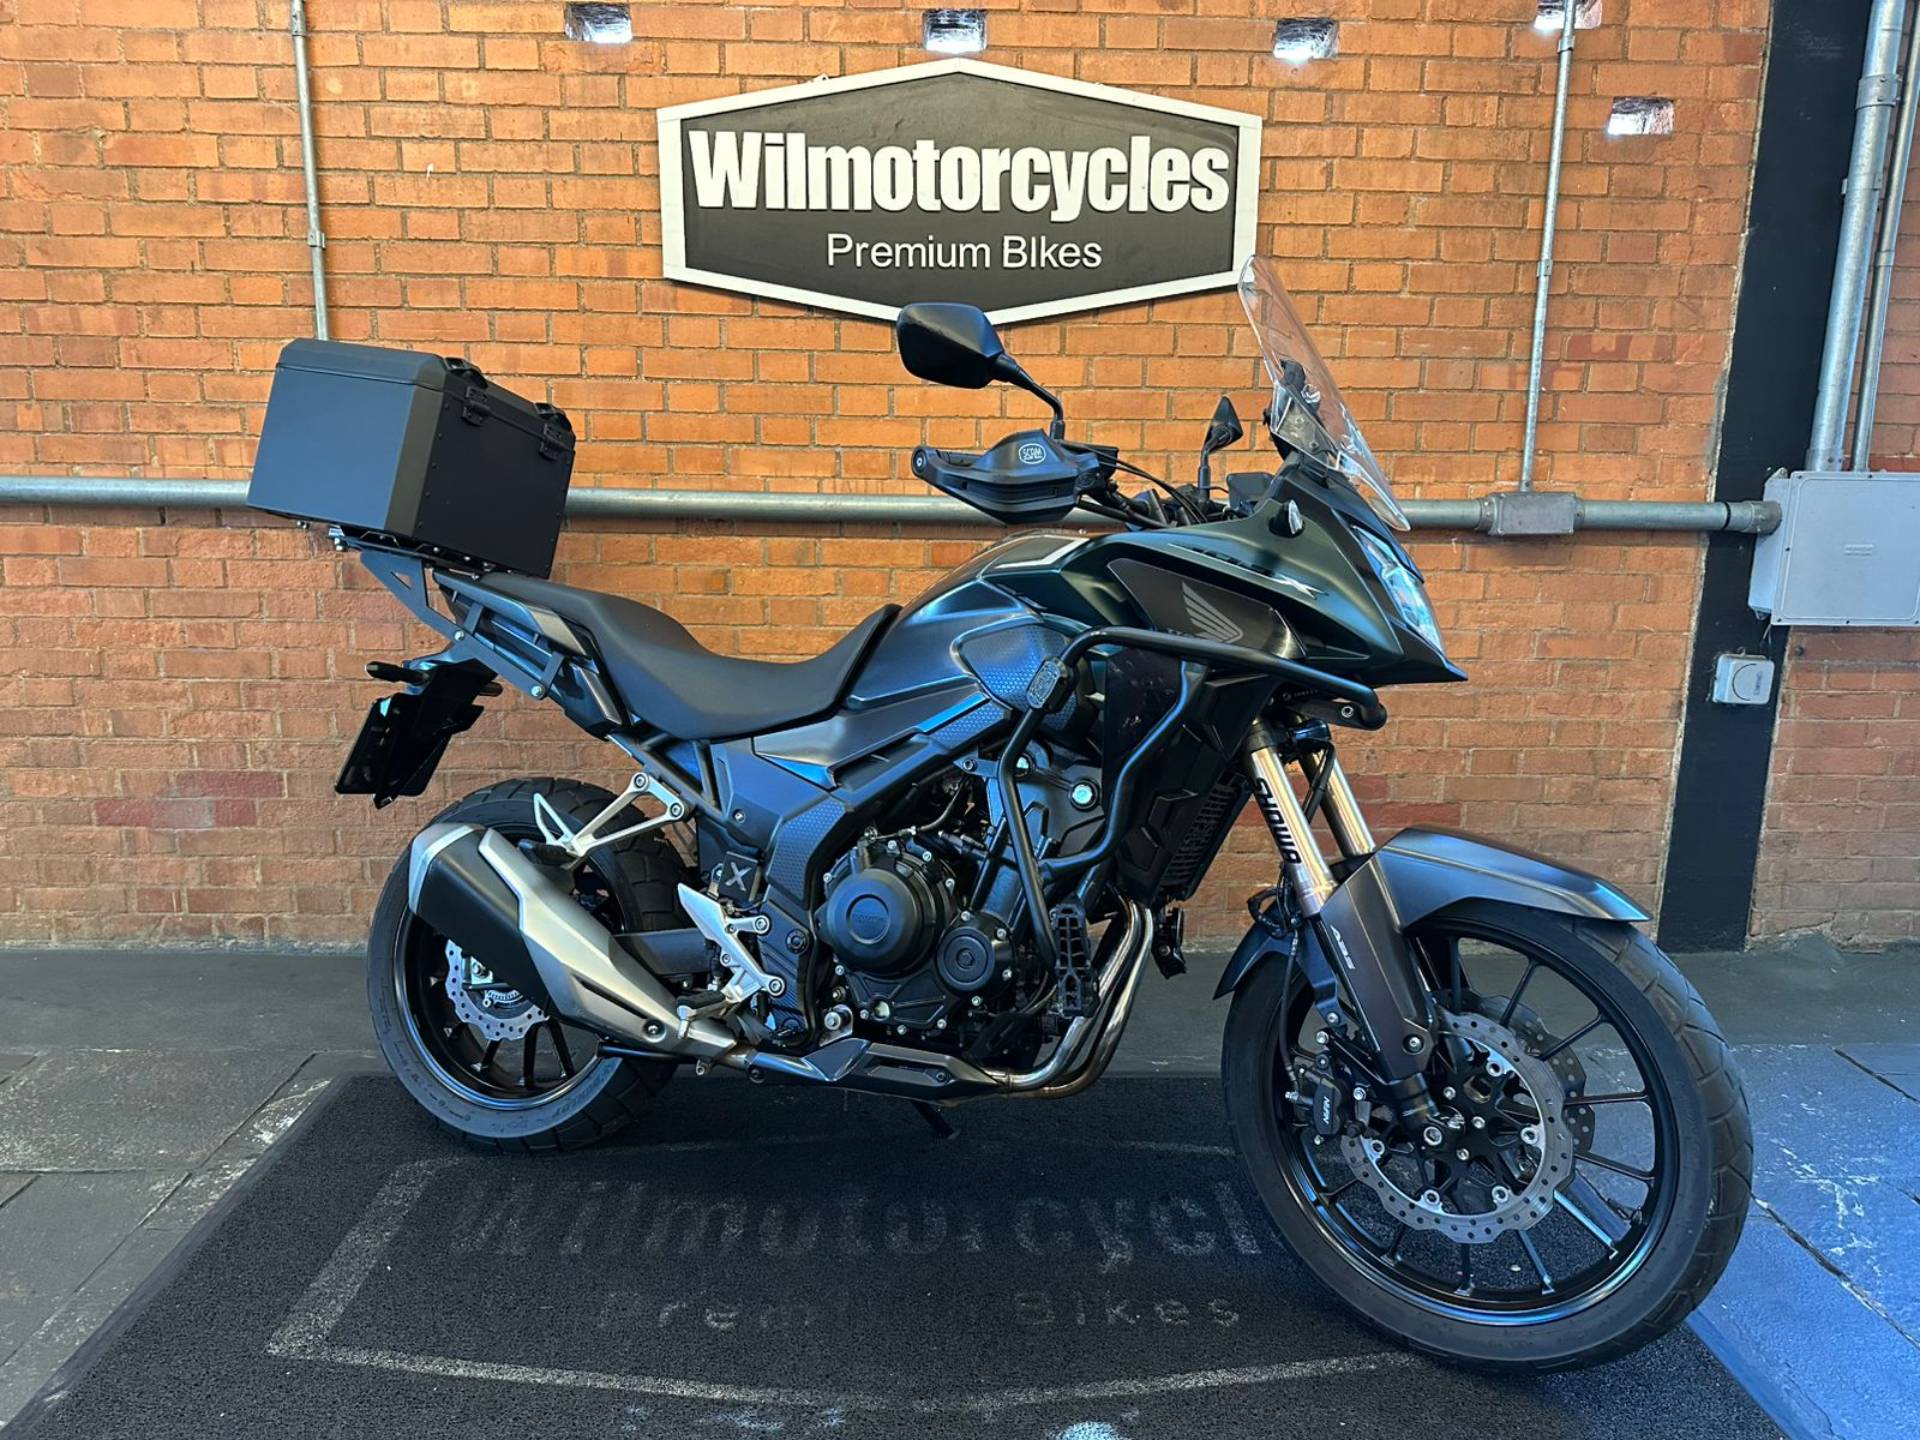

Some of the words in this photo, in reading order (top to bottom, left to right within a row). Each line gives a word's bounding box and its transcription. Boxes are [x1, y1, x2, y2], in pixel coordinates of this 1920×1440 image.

[689, 131, 1229, 221] Wilmotorcycles
[828, 234, 990, 267] Premium
[1255, 777, 1302, 864] SHOWA
